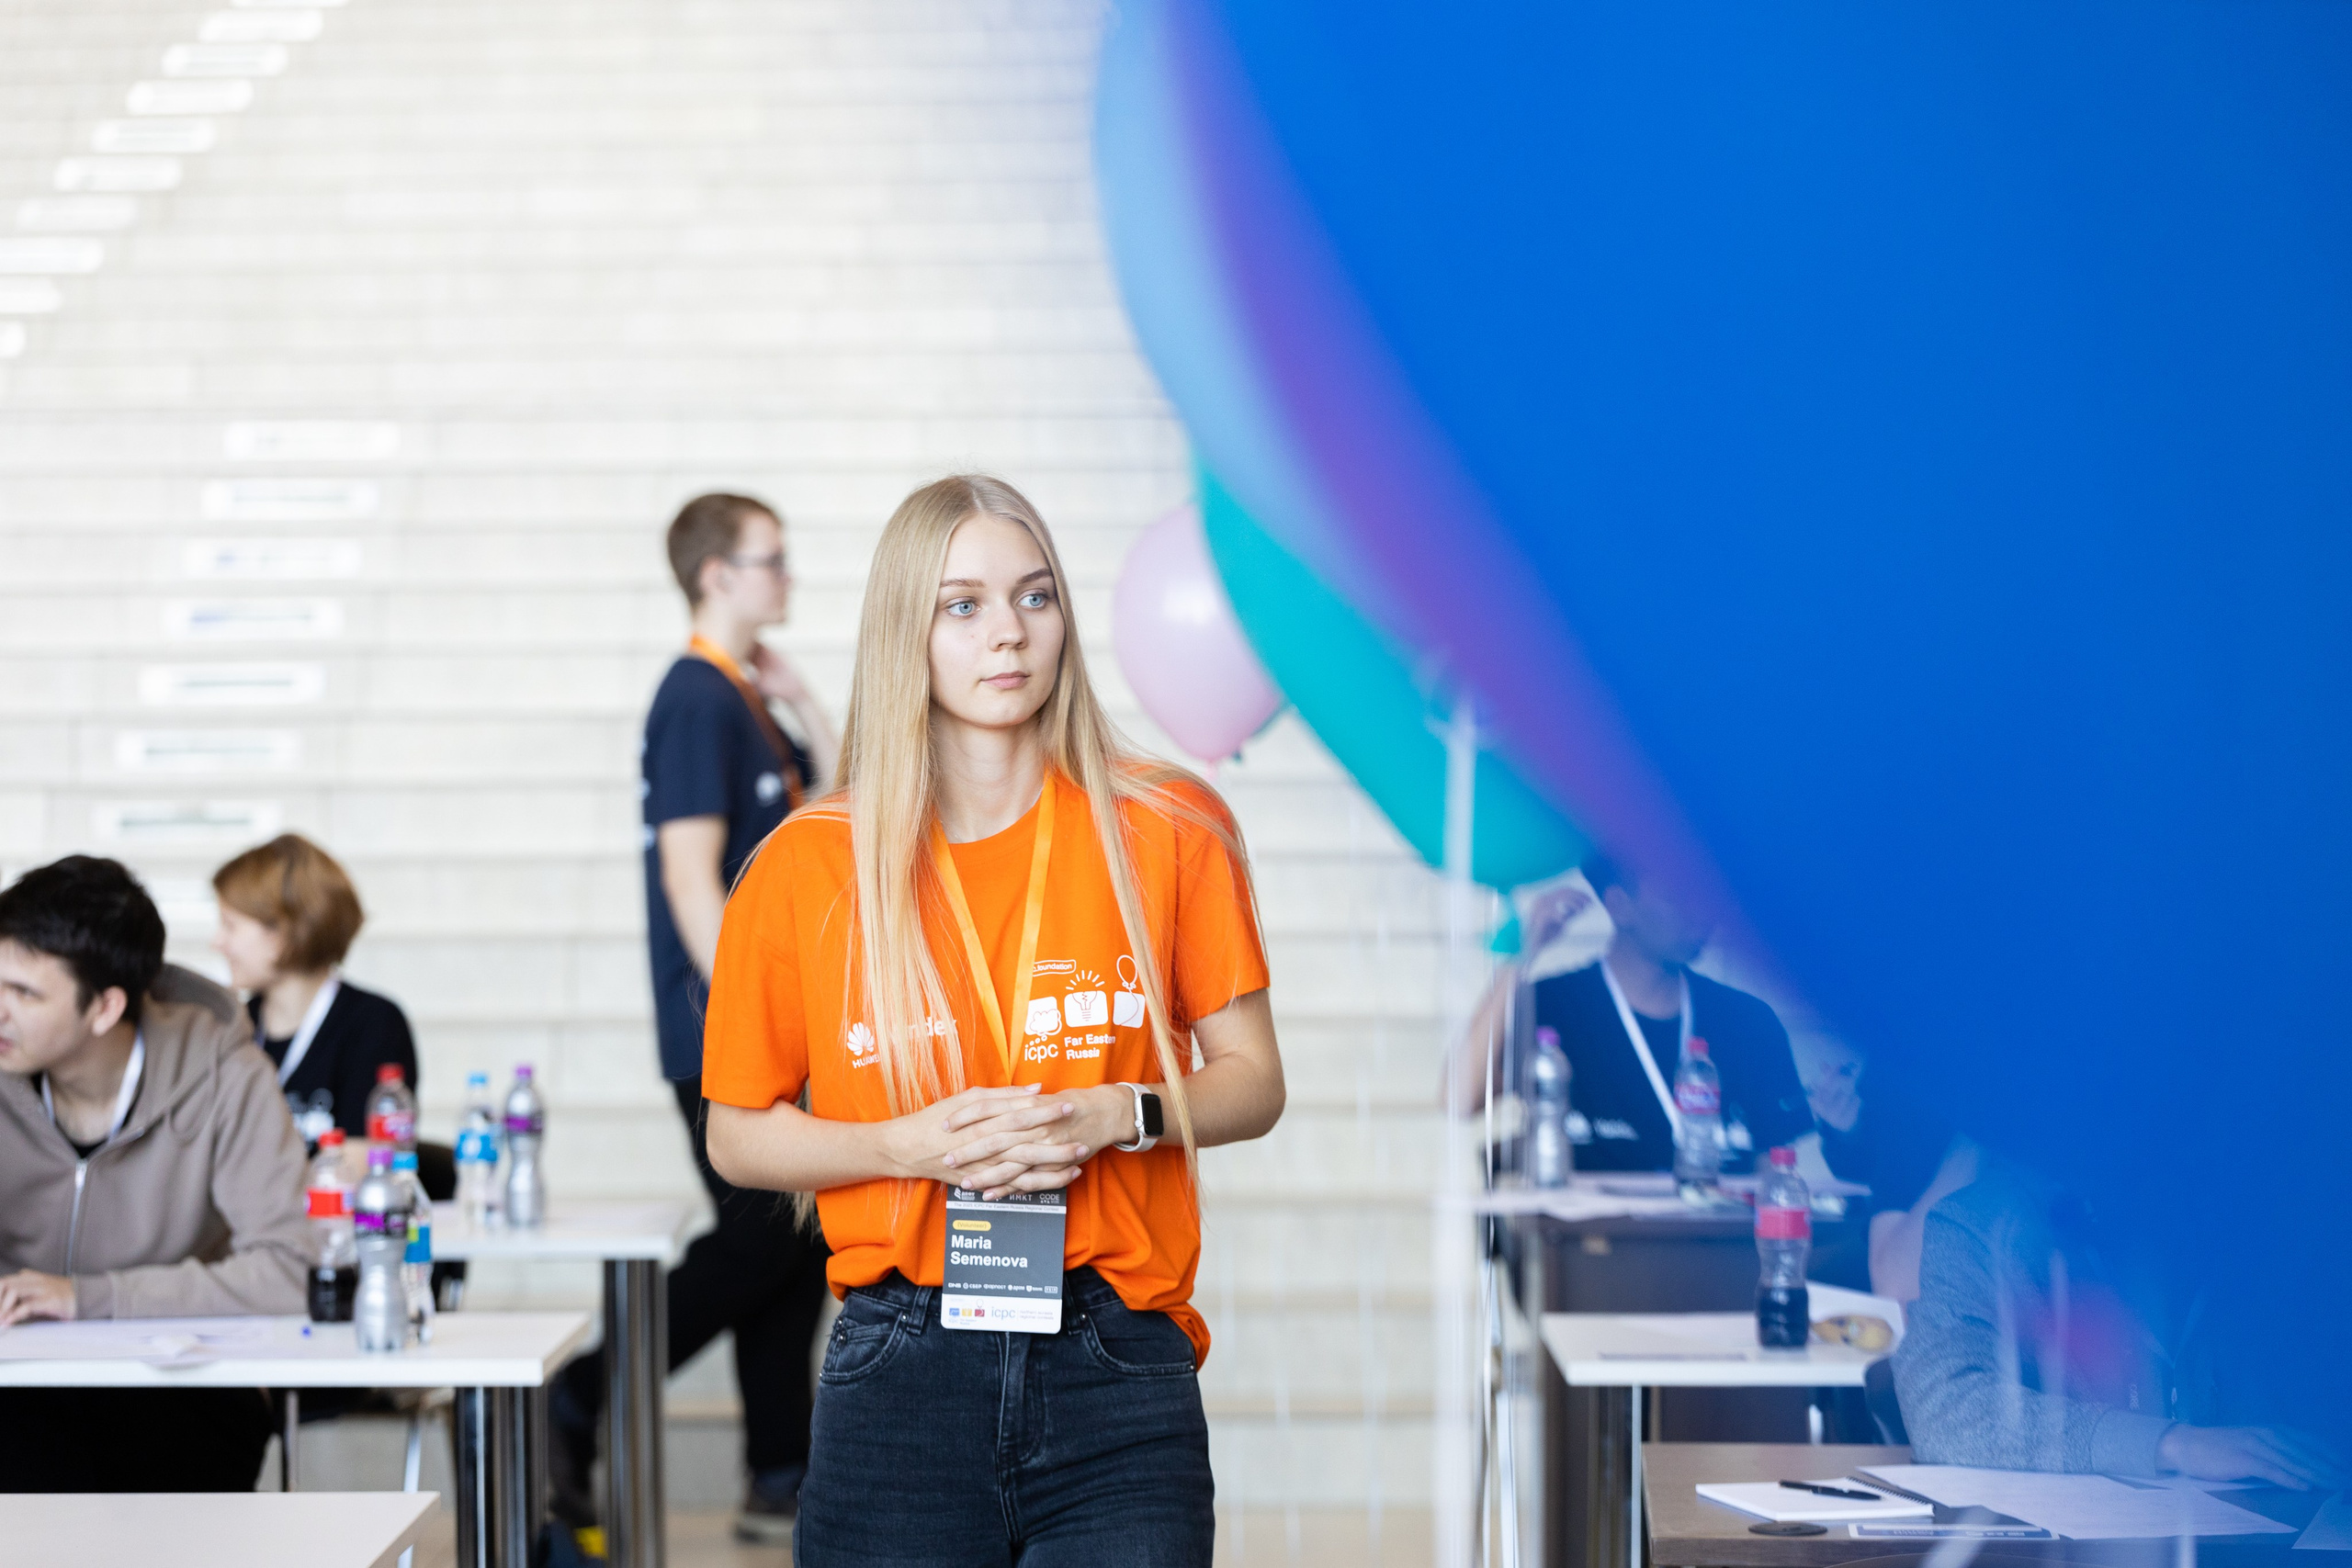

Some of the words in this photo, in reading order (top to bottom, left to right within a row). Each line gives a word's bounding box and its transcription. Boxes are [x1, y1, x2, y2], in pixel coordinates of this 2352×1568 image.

[1064, 1036, 1084, 1047] Far
[1024, 1043, 1059, 1064] icpc
[1039, 1192, 1060, 1201] CODE
[951, 1235, 992, 1250] Maria
[950, 1251, 1028, 1269] Semenova
[991, 1306, 1016, 1321] icpc
